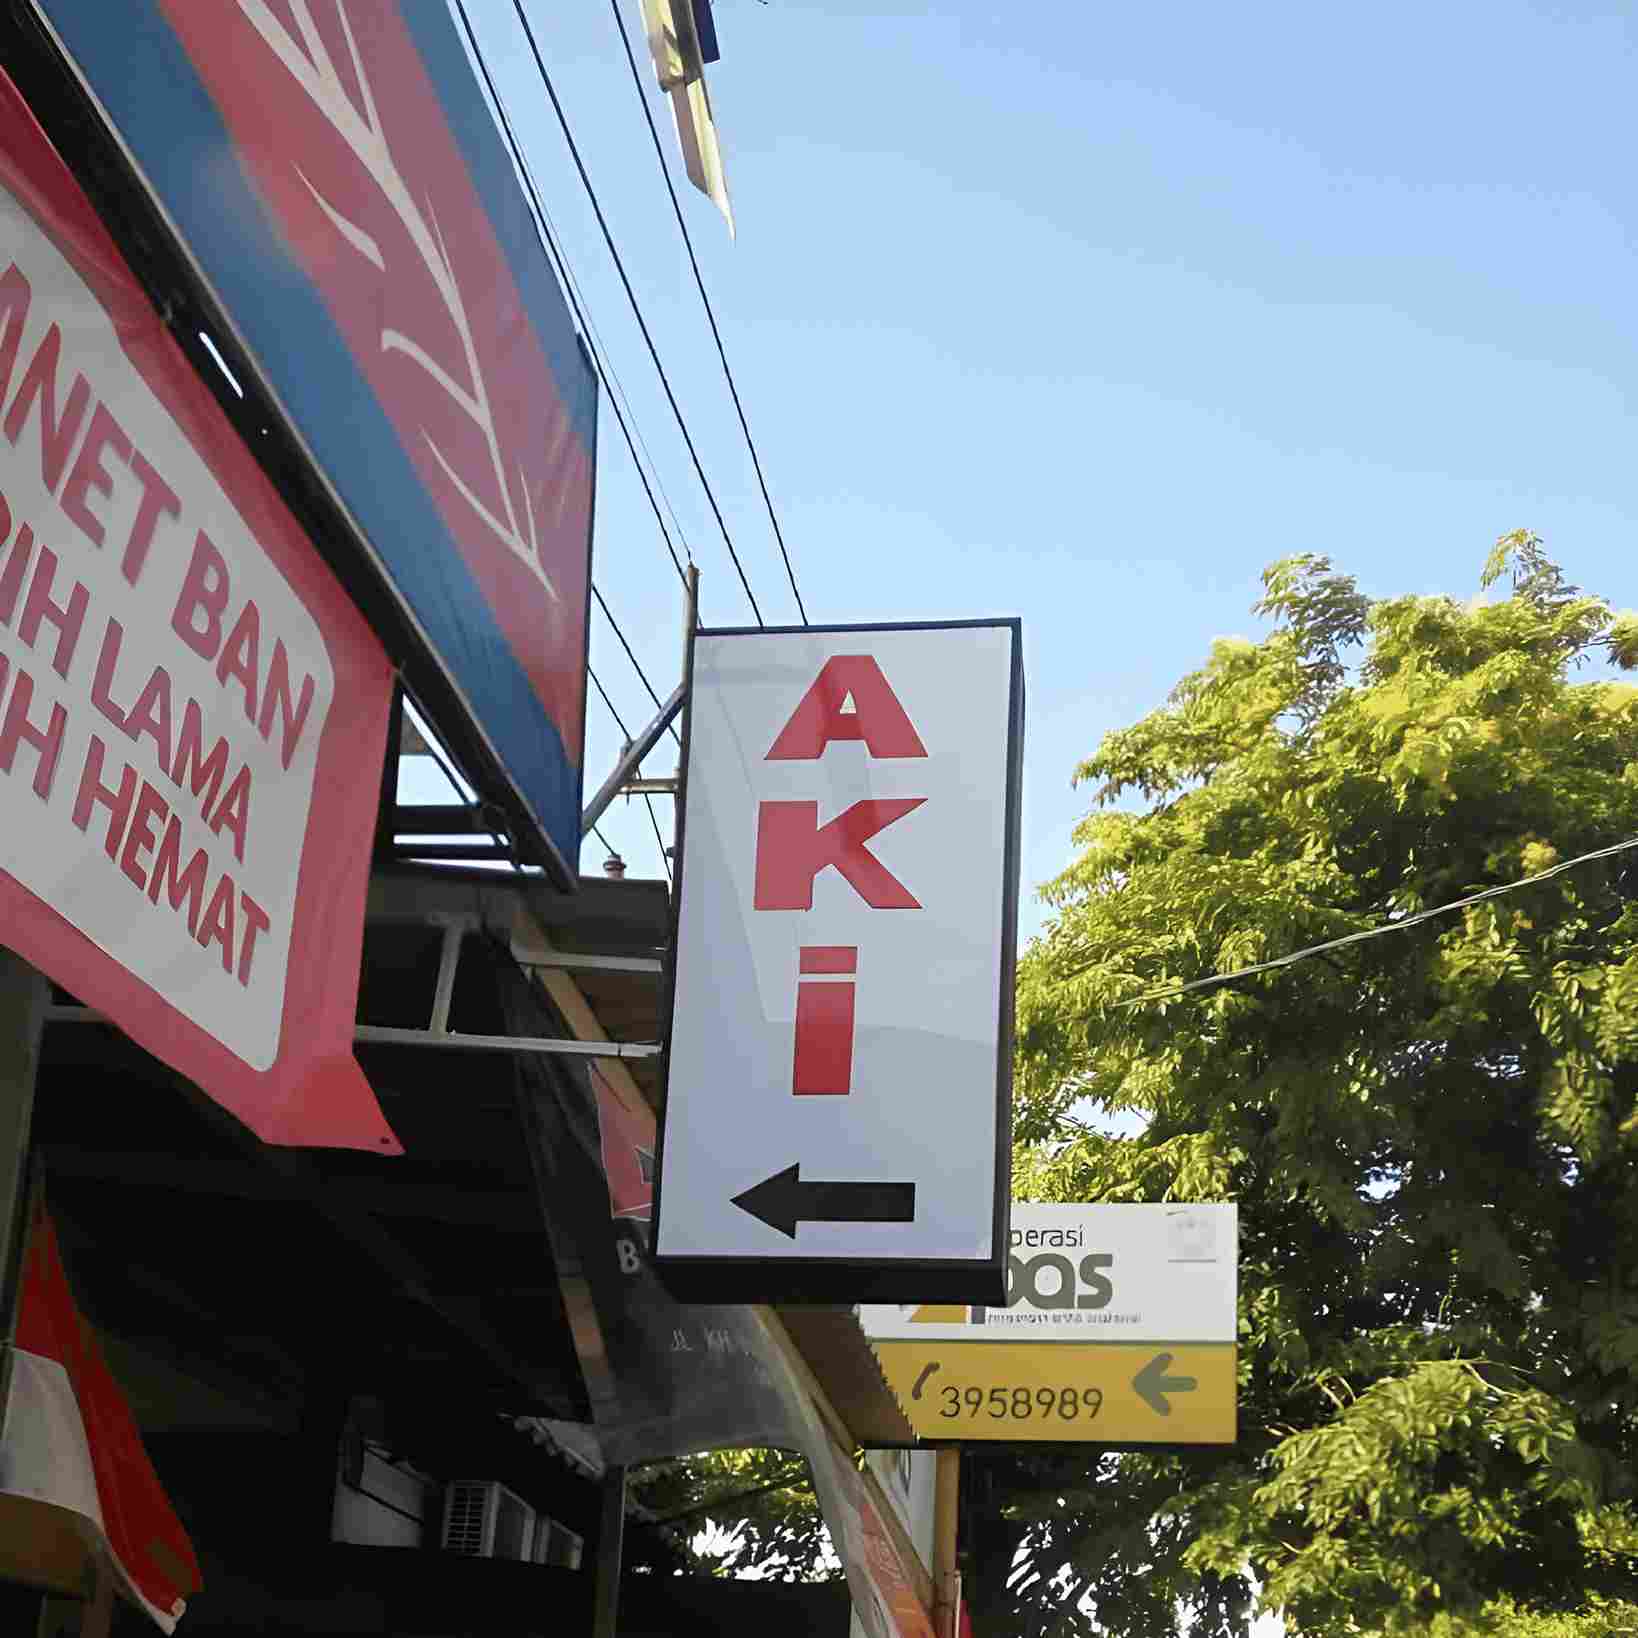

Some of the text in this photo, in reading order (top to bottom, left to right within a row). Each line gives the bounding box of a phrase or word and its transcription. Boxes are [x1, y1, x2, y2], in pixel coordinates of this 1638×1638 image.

[91, 615, 253, 864] LAMA
[171, 528, 315, 771] BAN
[72, 734, 271, 987] HEMAT
[939, 1386, 1104, 1420] 3958989
